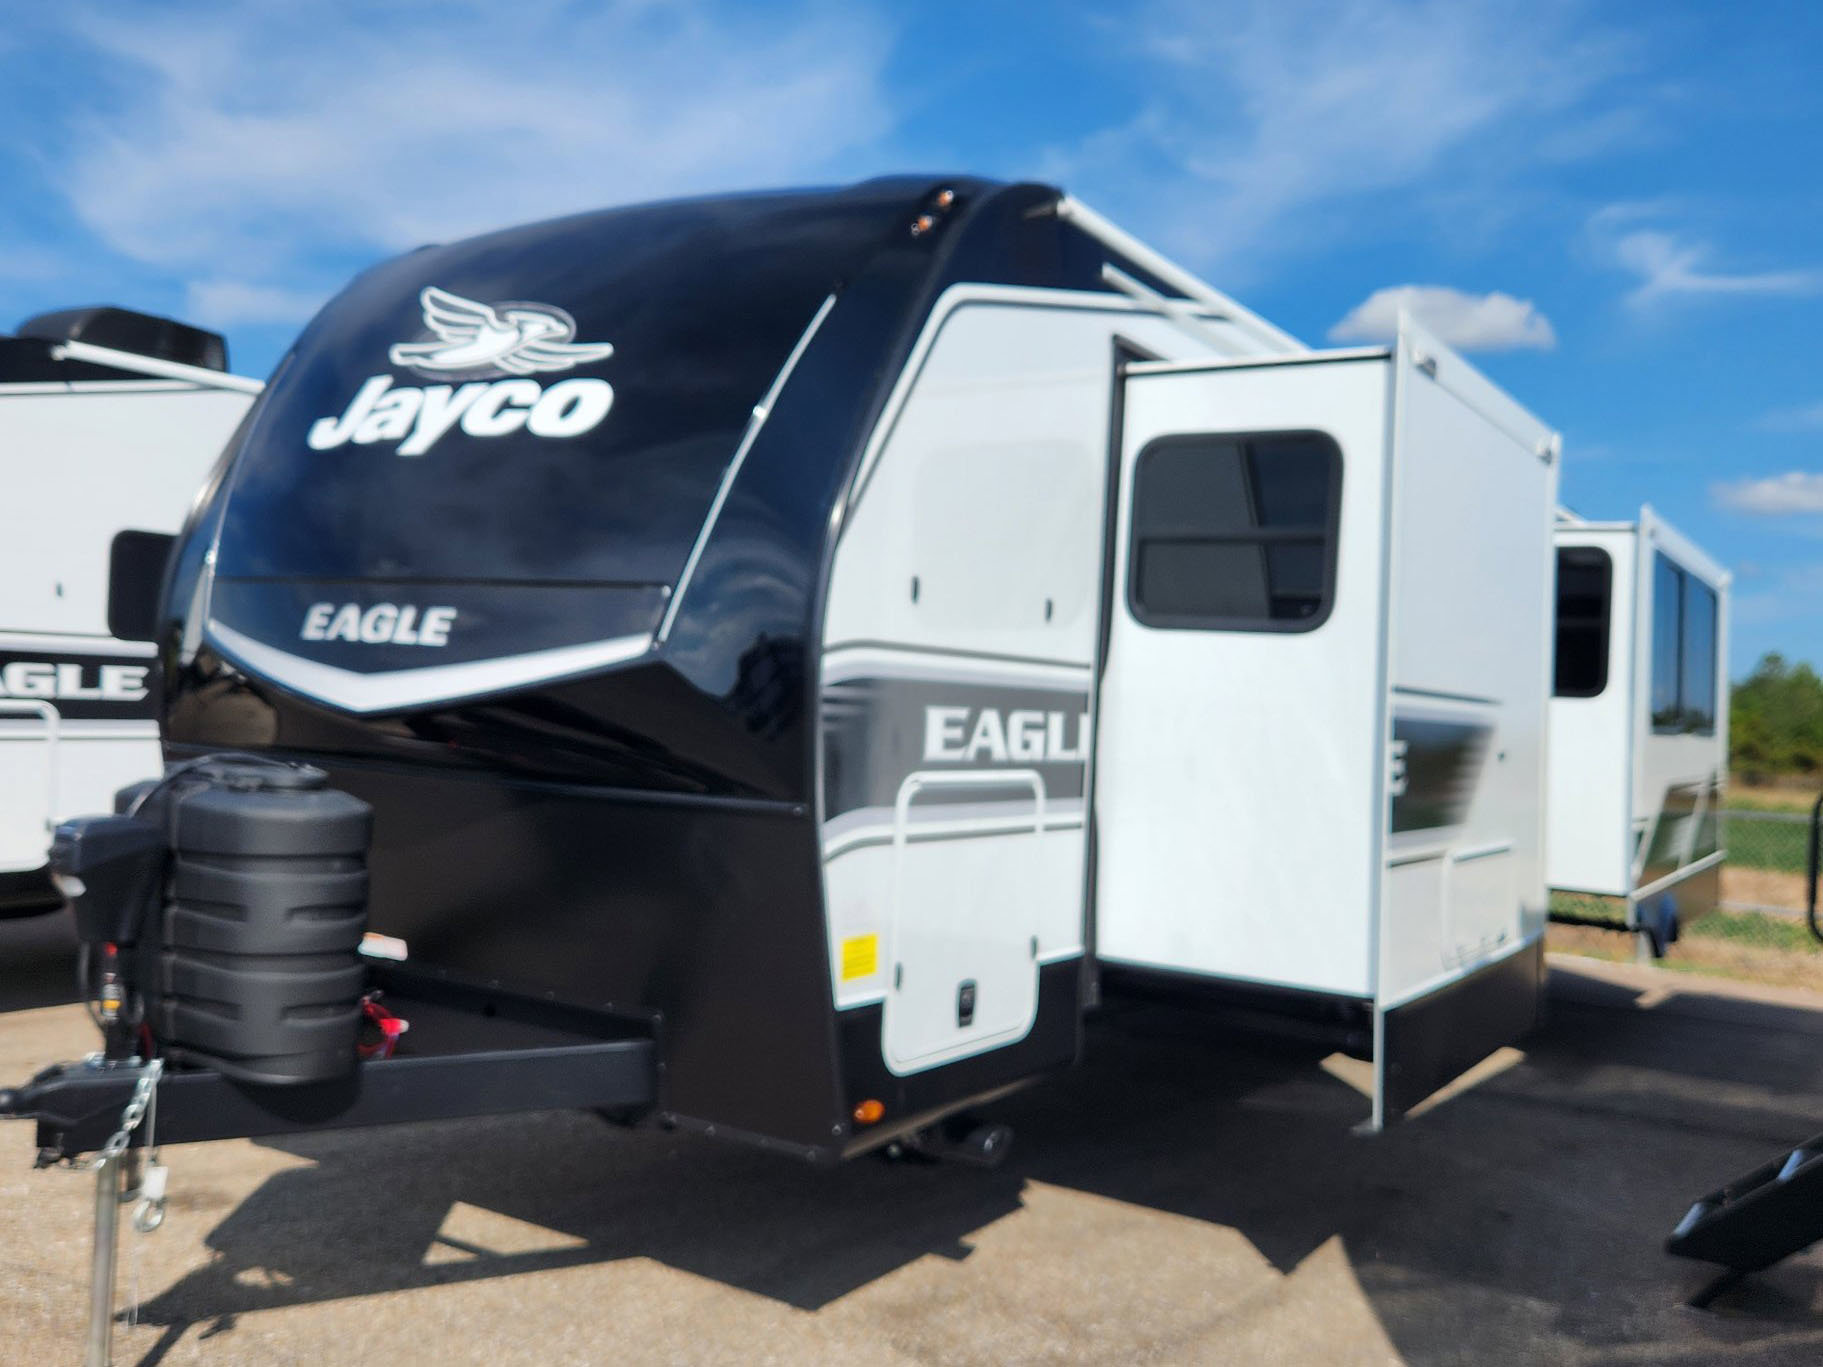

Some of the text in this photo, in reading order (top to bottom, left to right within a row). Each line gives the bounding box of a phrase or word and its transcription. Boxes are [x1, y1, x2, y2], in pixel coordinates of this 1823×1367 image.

[308, 374, 613, 455] Jayco
[301, 602, 457, 647] EAGLE
[0, 661, 149, 700] GLE
